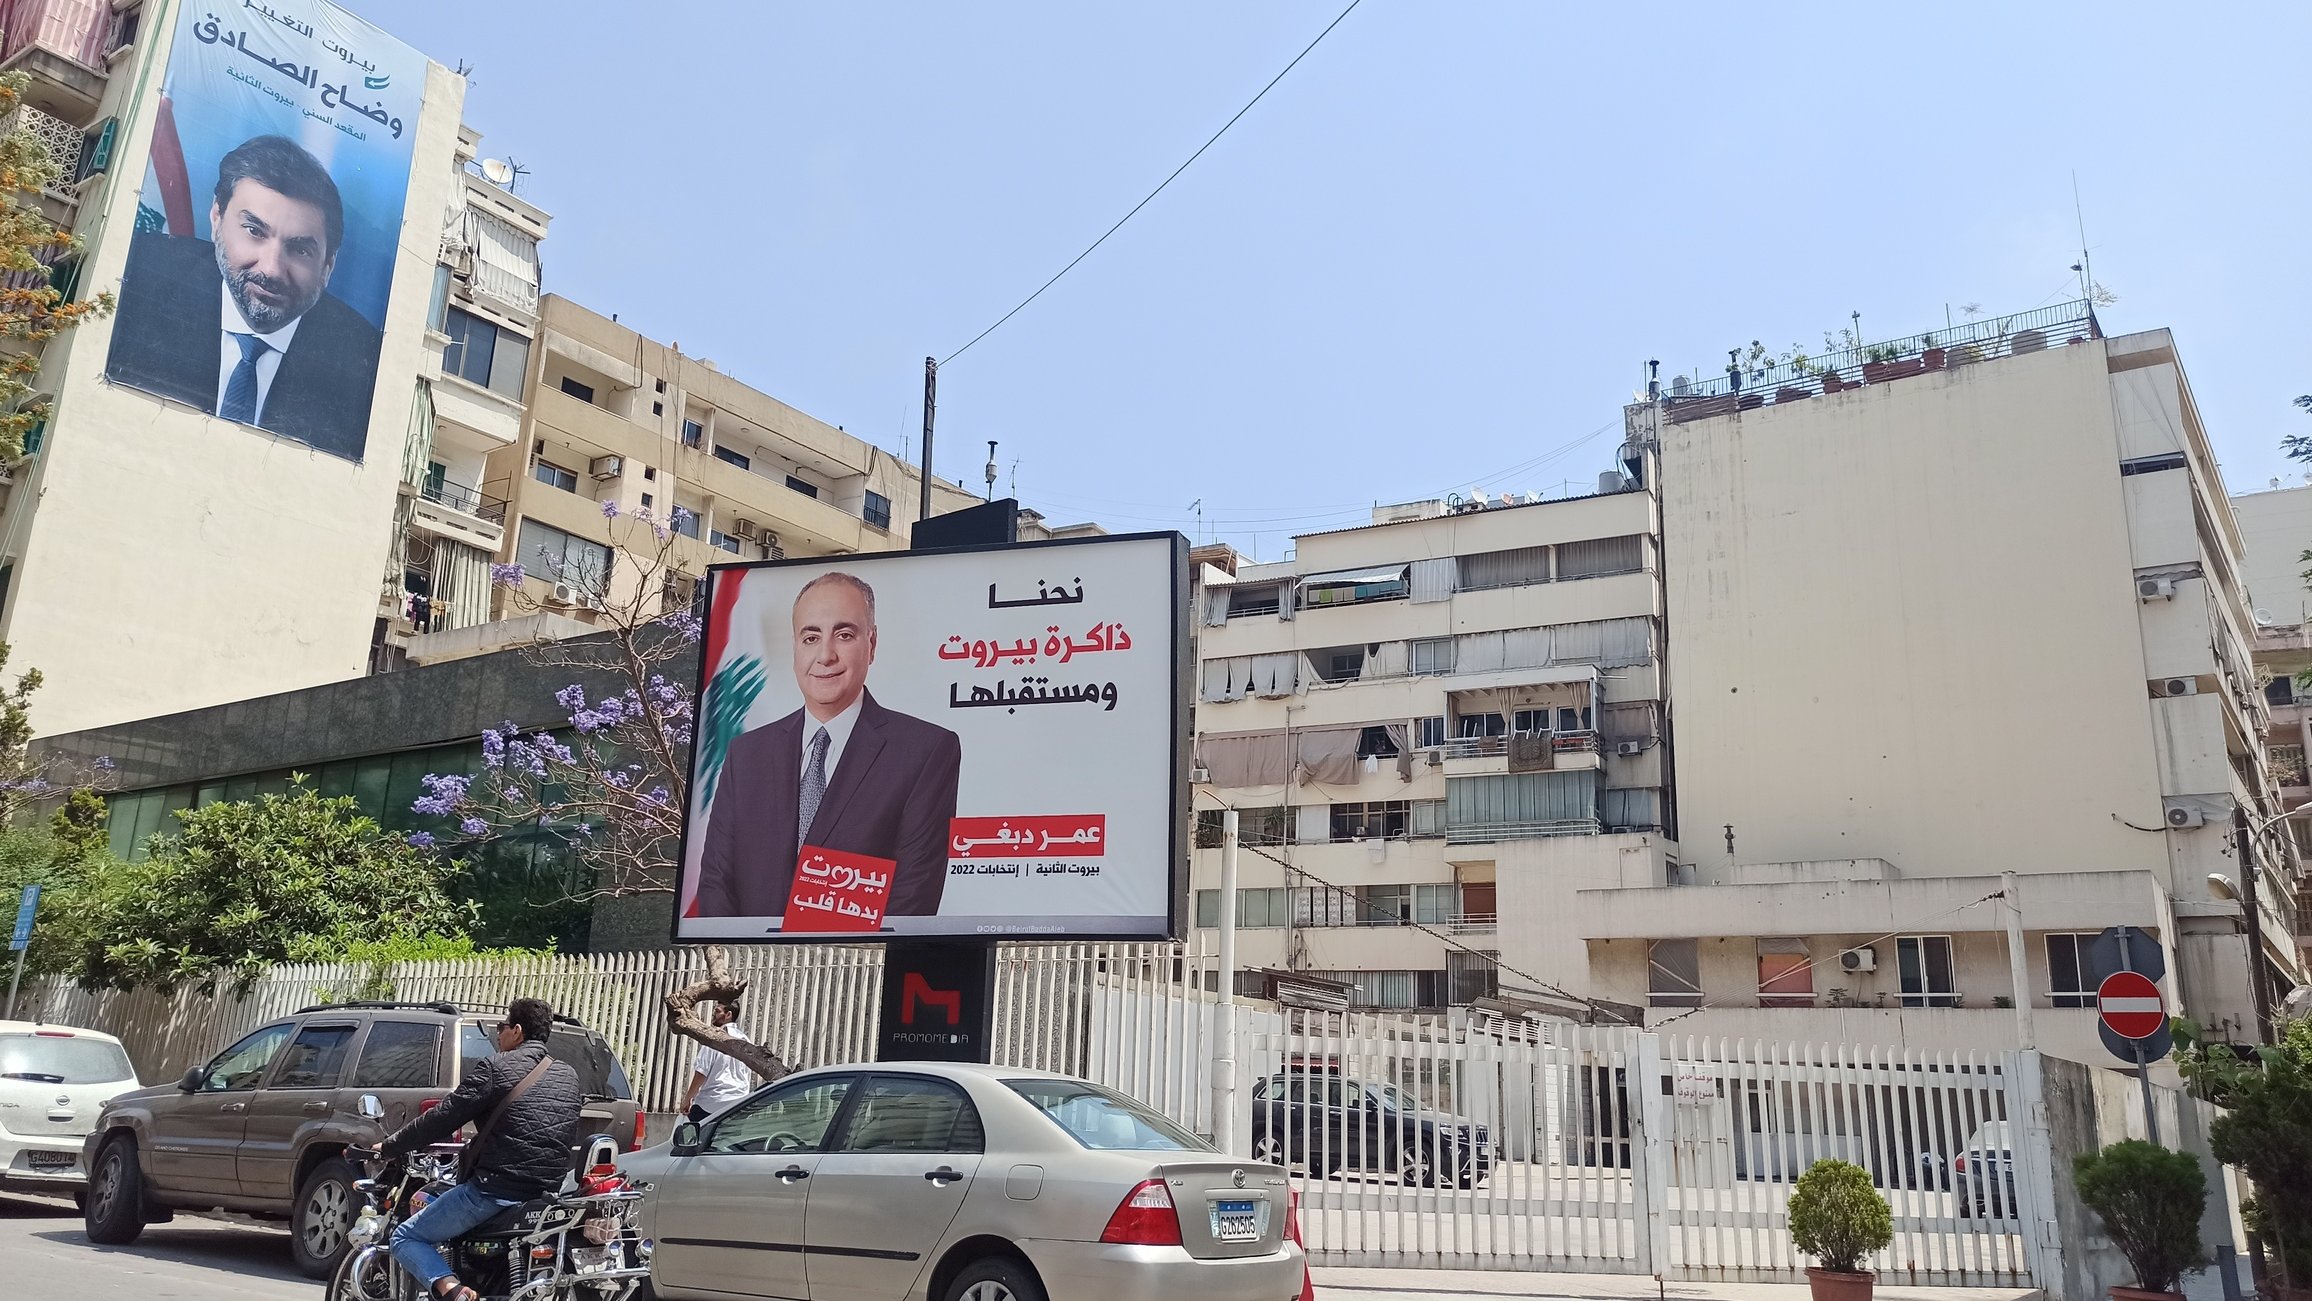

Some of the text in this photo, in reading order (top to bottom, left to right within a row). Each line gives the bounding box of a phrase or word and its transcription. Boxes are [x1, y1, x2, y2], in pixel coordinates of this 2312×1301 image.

[242, 0, 376, 73] بيروت التغيير
[193, 13, 403, 139] وضاح الصادق
[226, 66, 262, 90] الثانية
[263, 85, 295, 107] بيروت
[302, 106, 332, 126] السني
[334, 118, 366, 141] المقعد
[988, 576, 1084, 609] نحنا
[938, 621, 1131, 668] ذاكرة بيروت
[950, 676, 1118, 715] ومستقبلها
[952, 822, 1101, 857] عمر دبغي
[802, 855, 887, 895] بيروت
[950, 864, 975, 875] 2022
[1036, 861, 1066, 876] الثانية
[1067, 863, 1100, 877] بيروت
[793, 891, 879, 925] بدها قلب
[1221, 1215, 1256, 1236] G262505
